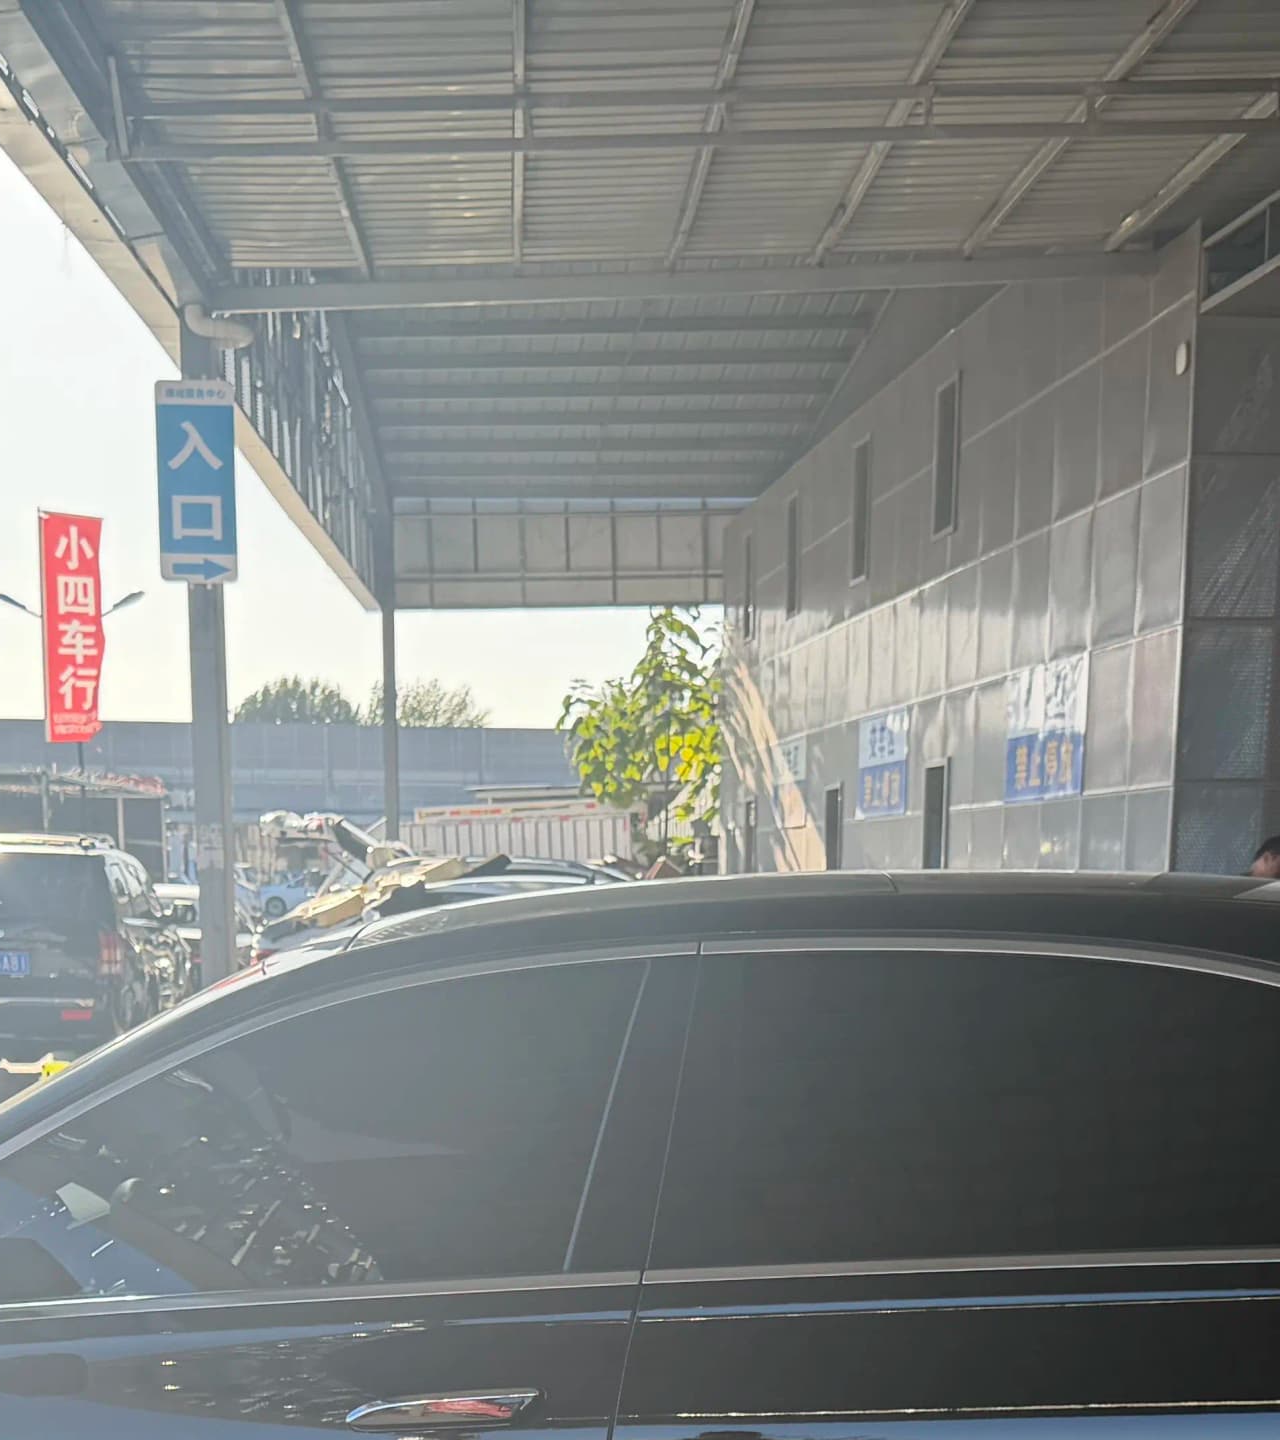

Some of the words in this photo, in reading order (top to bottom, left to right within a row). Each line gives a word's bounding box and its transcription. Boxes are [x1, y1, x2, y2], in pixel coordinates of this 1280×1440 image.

[167, 421, 224, 541] 入口
[54, 525, 99, 711] 小四车行
